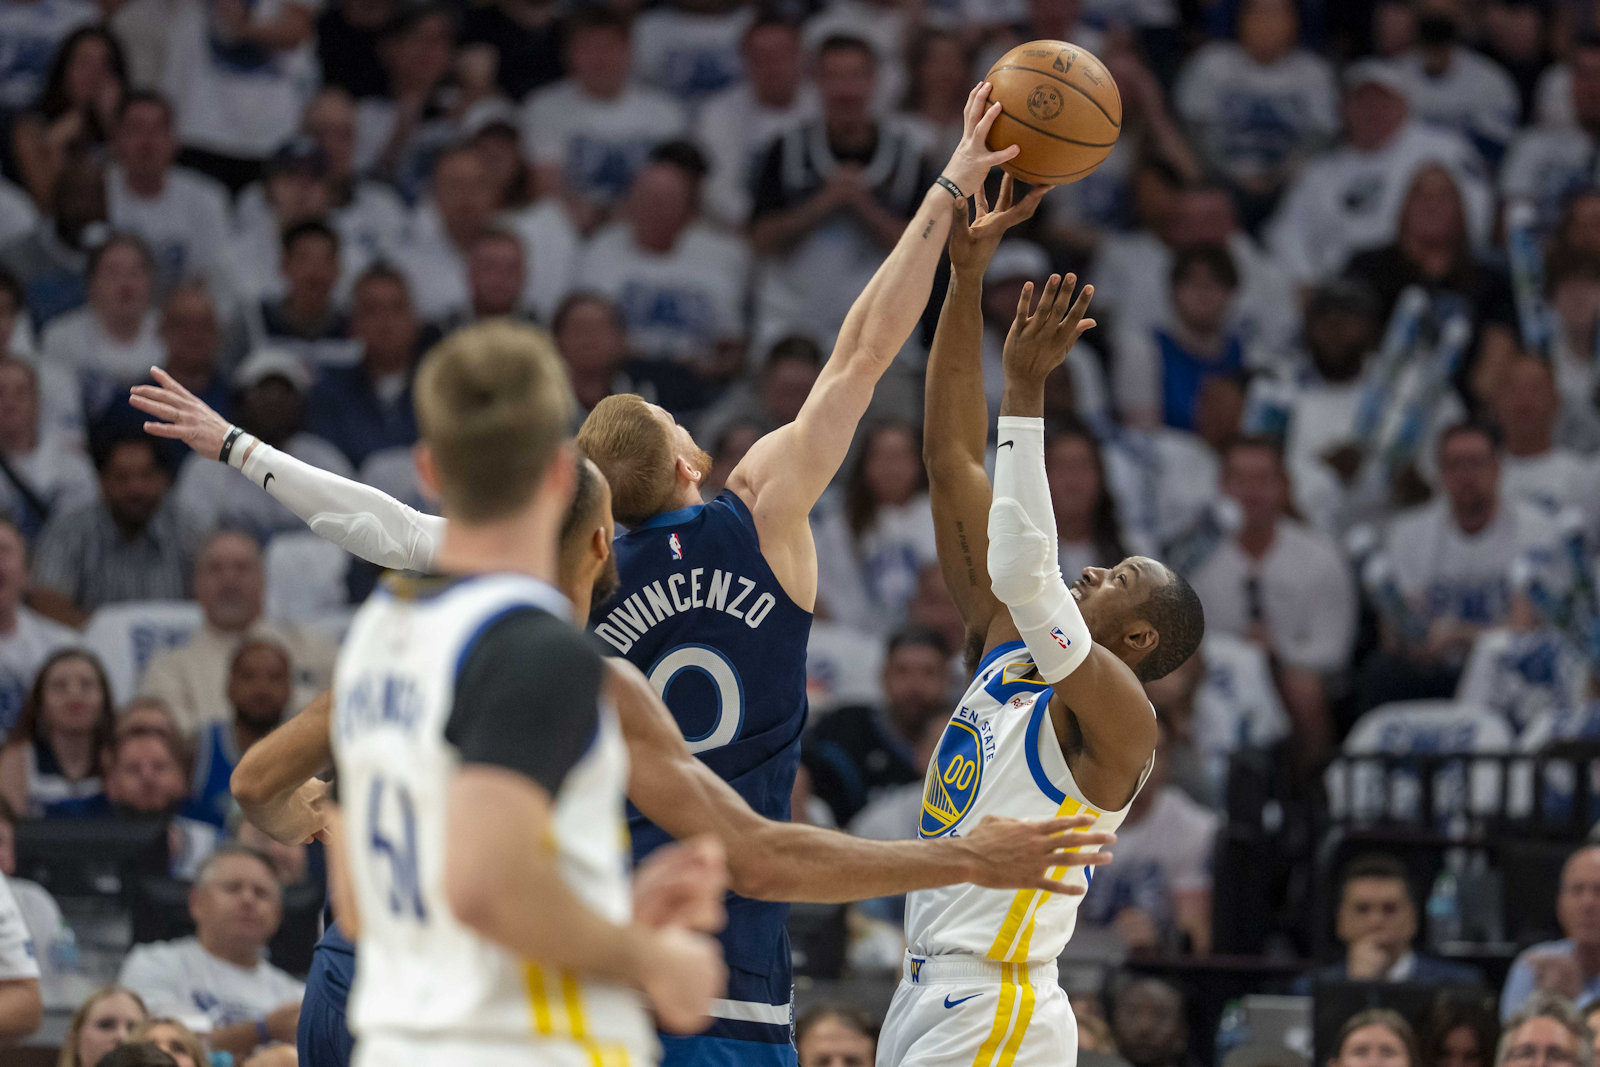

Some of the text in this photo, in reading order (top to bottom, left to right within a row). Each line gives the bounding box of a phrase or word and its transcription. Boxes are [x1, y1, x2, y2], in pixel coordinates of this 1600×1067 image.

[593, 567, 776, 655] DIVINCENZO
[646, 642, 745, 755] 0
[943, 754, 976, 791] 00
[981, 720, 996, 762] STATE
